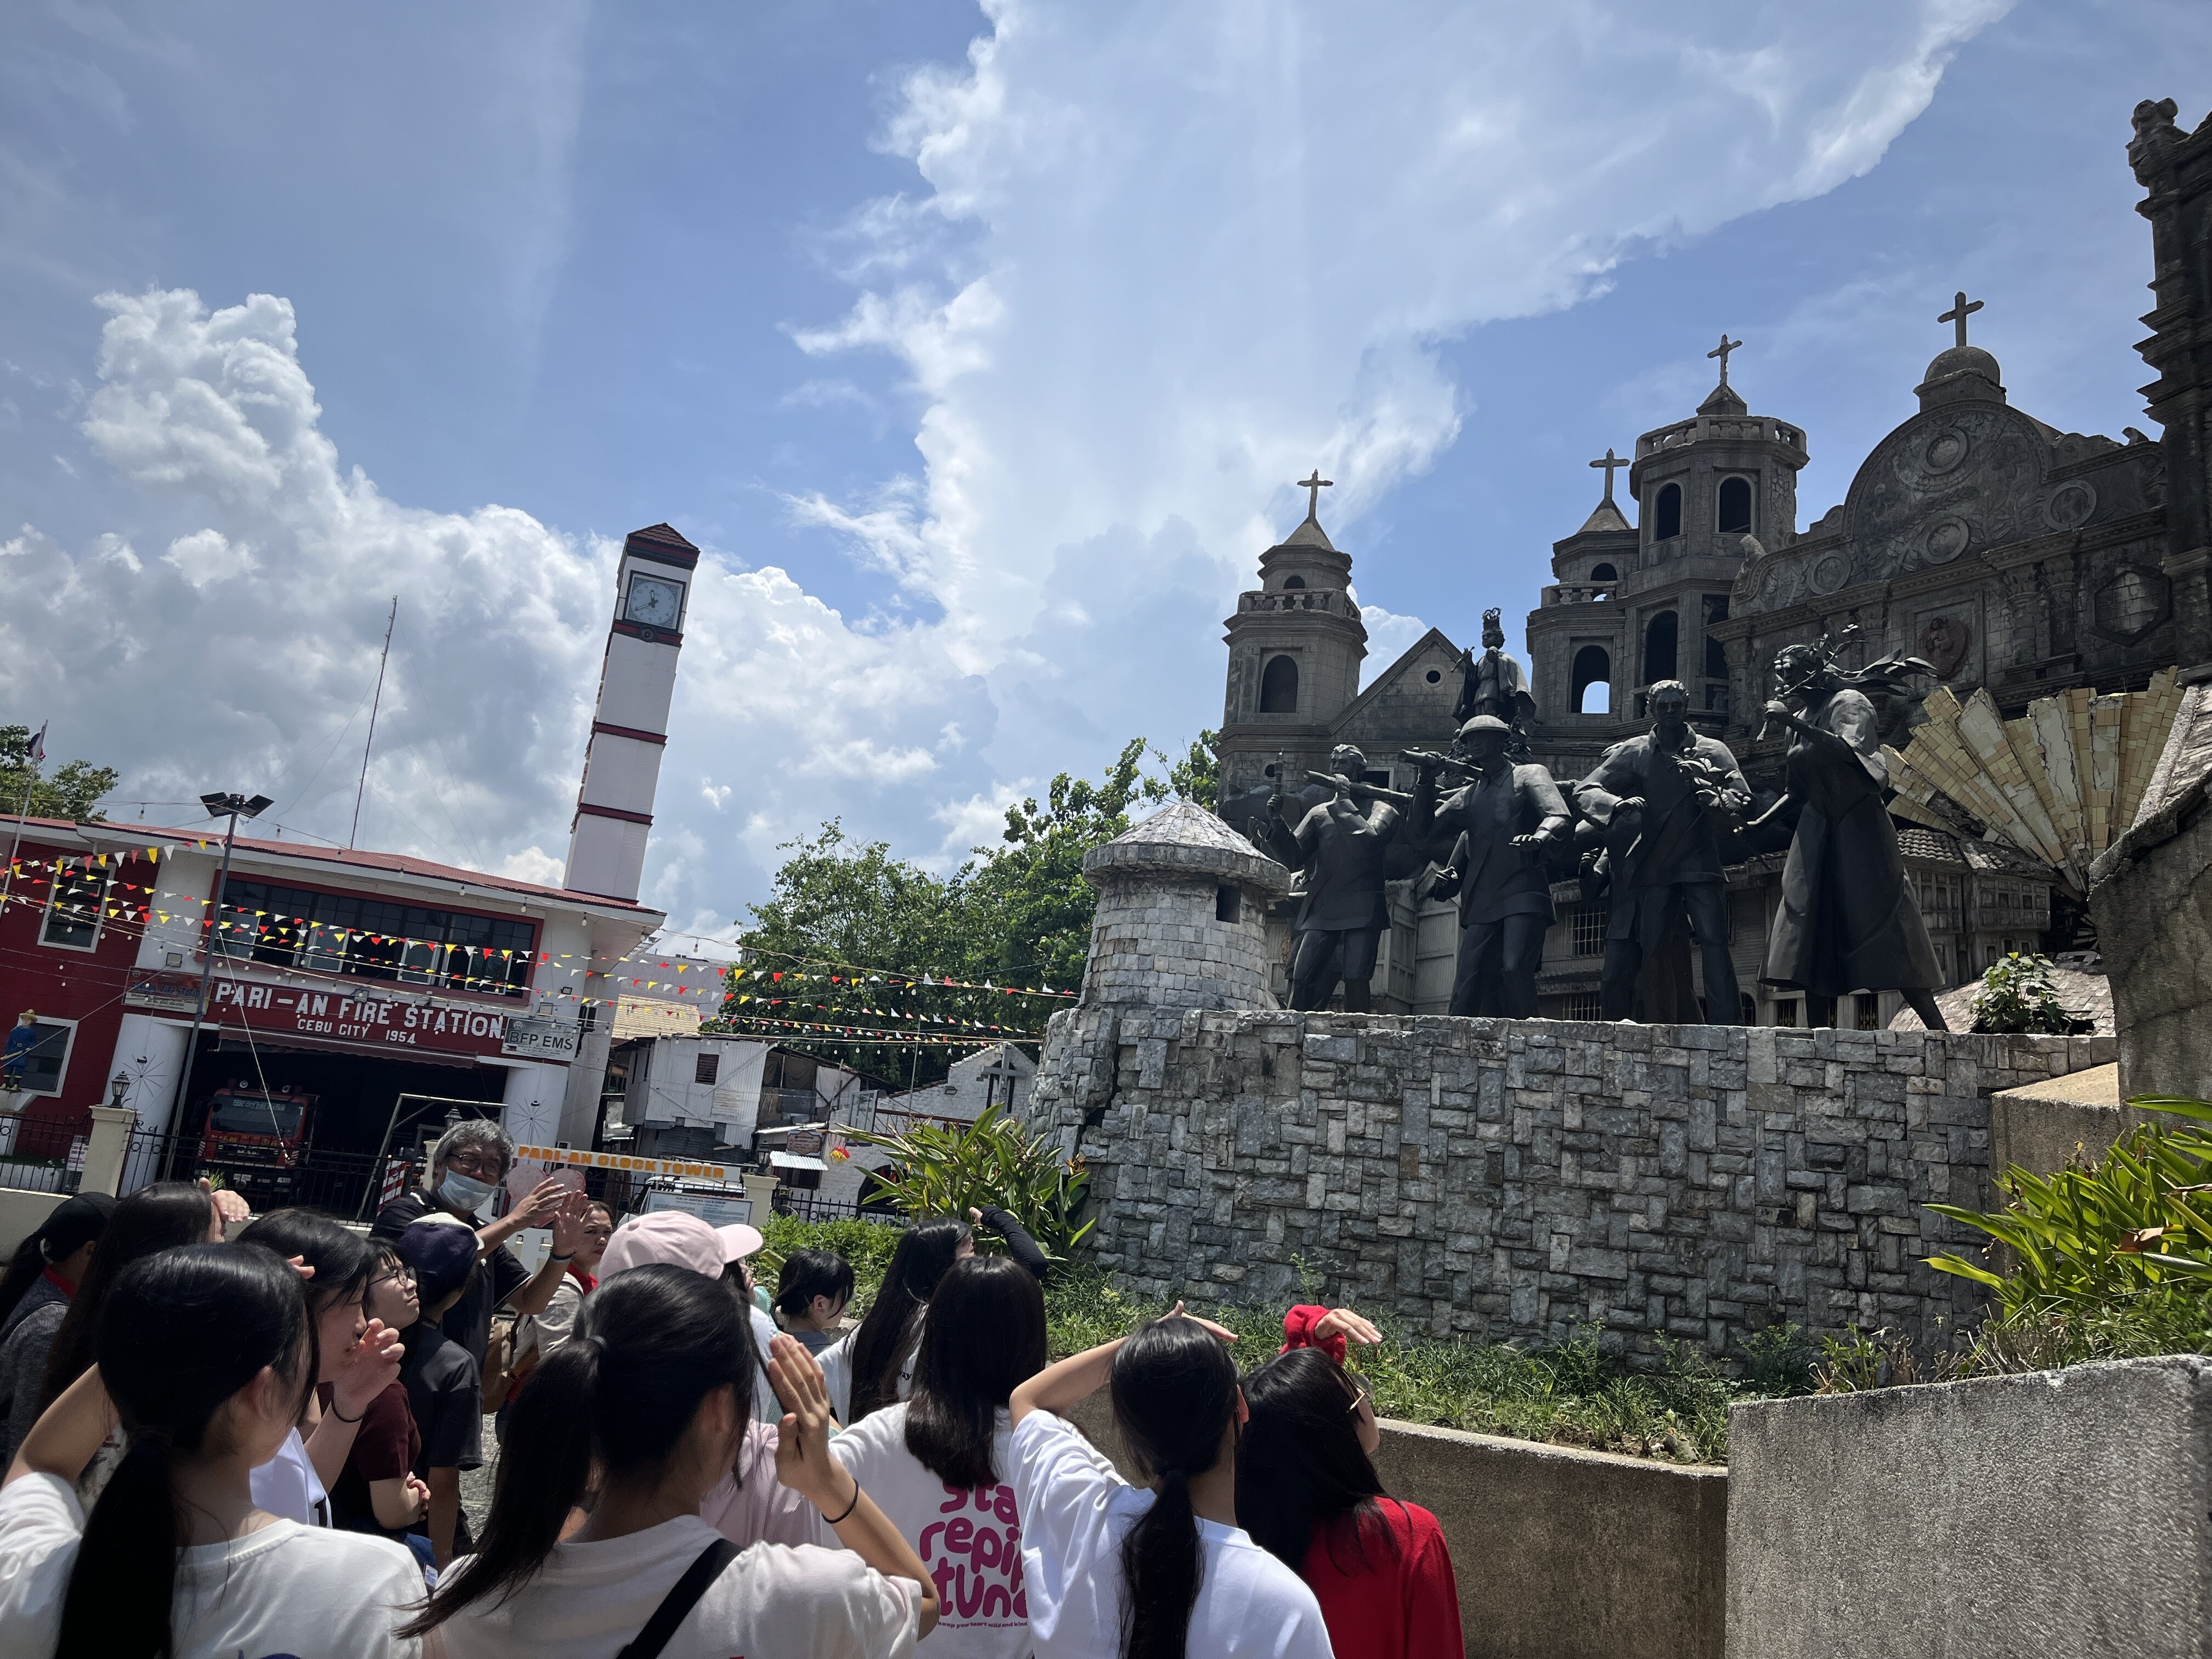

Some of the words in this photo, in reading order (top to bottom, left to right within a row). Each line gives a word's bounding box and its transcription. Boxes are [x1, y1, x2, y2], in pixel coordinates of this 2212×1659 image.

[297, 1019, 332, 1032] CEBU
[338, 1024, 370, 1037] CITY
[385, 1030, 416, 1044] 1954
[338, 998, 393, 1024] FIRE
[404, 1007, 503, 1039] STATION
[510, 1031, 538, 1045] BFP
[543, 1036, 573, 1049] EMS
[518, 1146, 592, 1164] PARI-AN
[597, 1155, 657, 1171] CLOCK
[662, 1161, 725, 1178] TOWER
[940, 1481, 1019, 1527] sta
